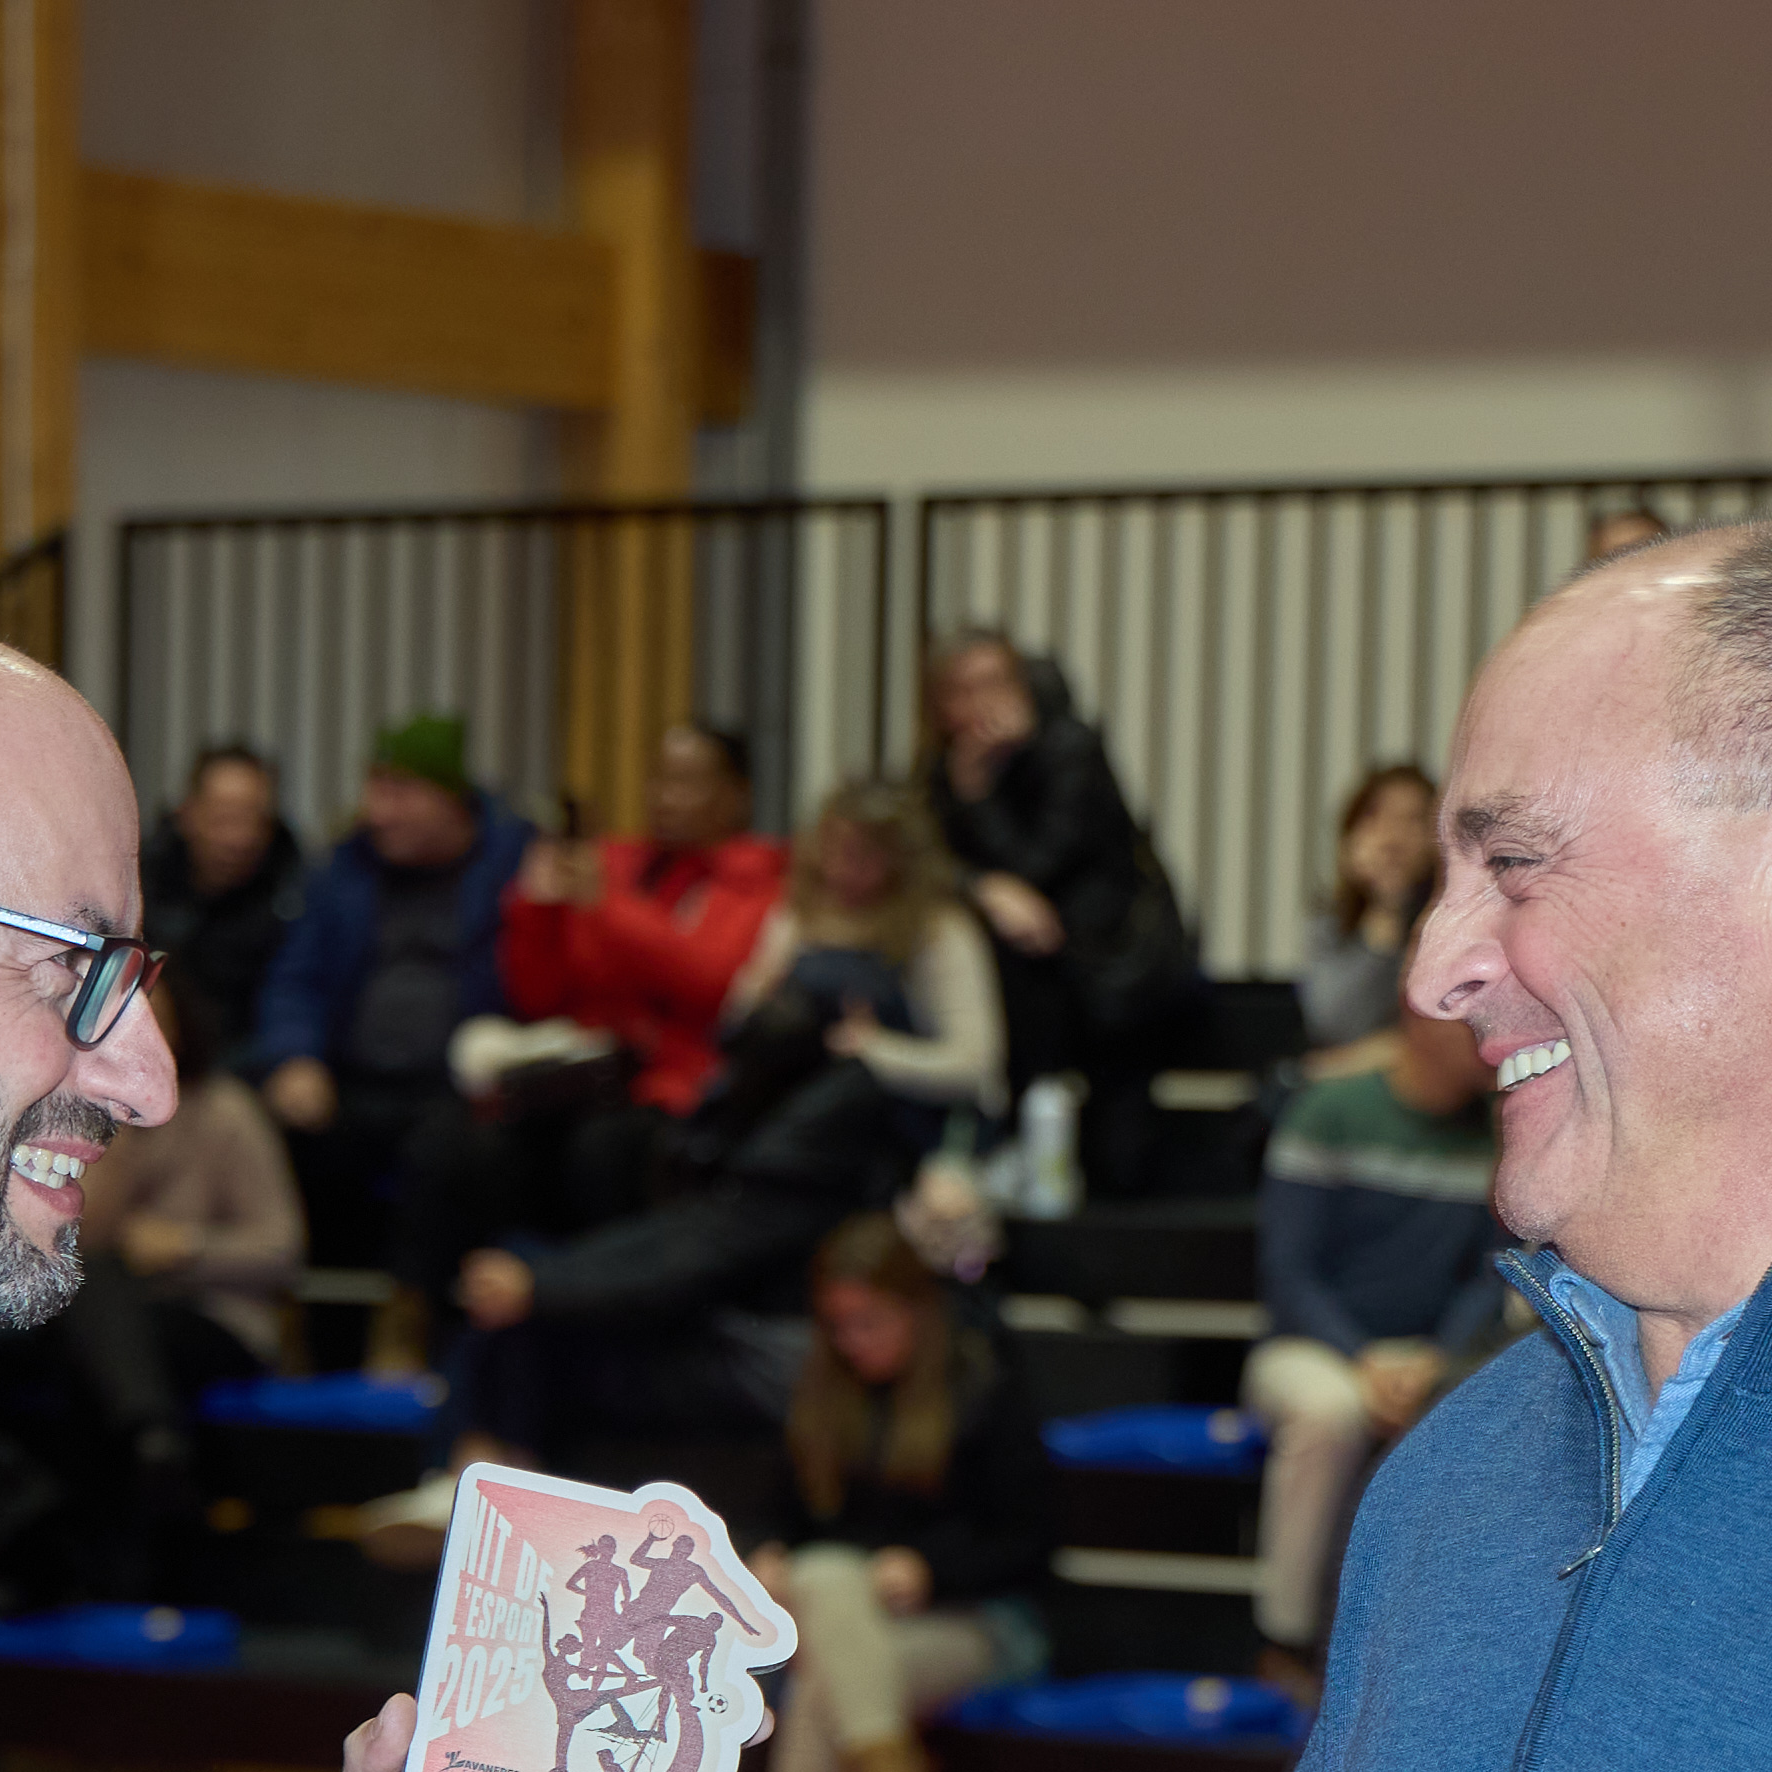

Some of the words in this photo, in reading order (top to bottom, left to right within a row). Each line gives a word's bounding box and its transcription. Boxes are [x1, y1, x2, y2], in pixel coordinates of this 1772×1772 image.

[460, 1490, 512, 1587] NIT
[514, 1539, 554, 1608] DE
[447, 1578, 544, 1645] L'ESPORT
[428, 1644, 538, 1742] 2025
